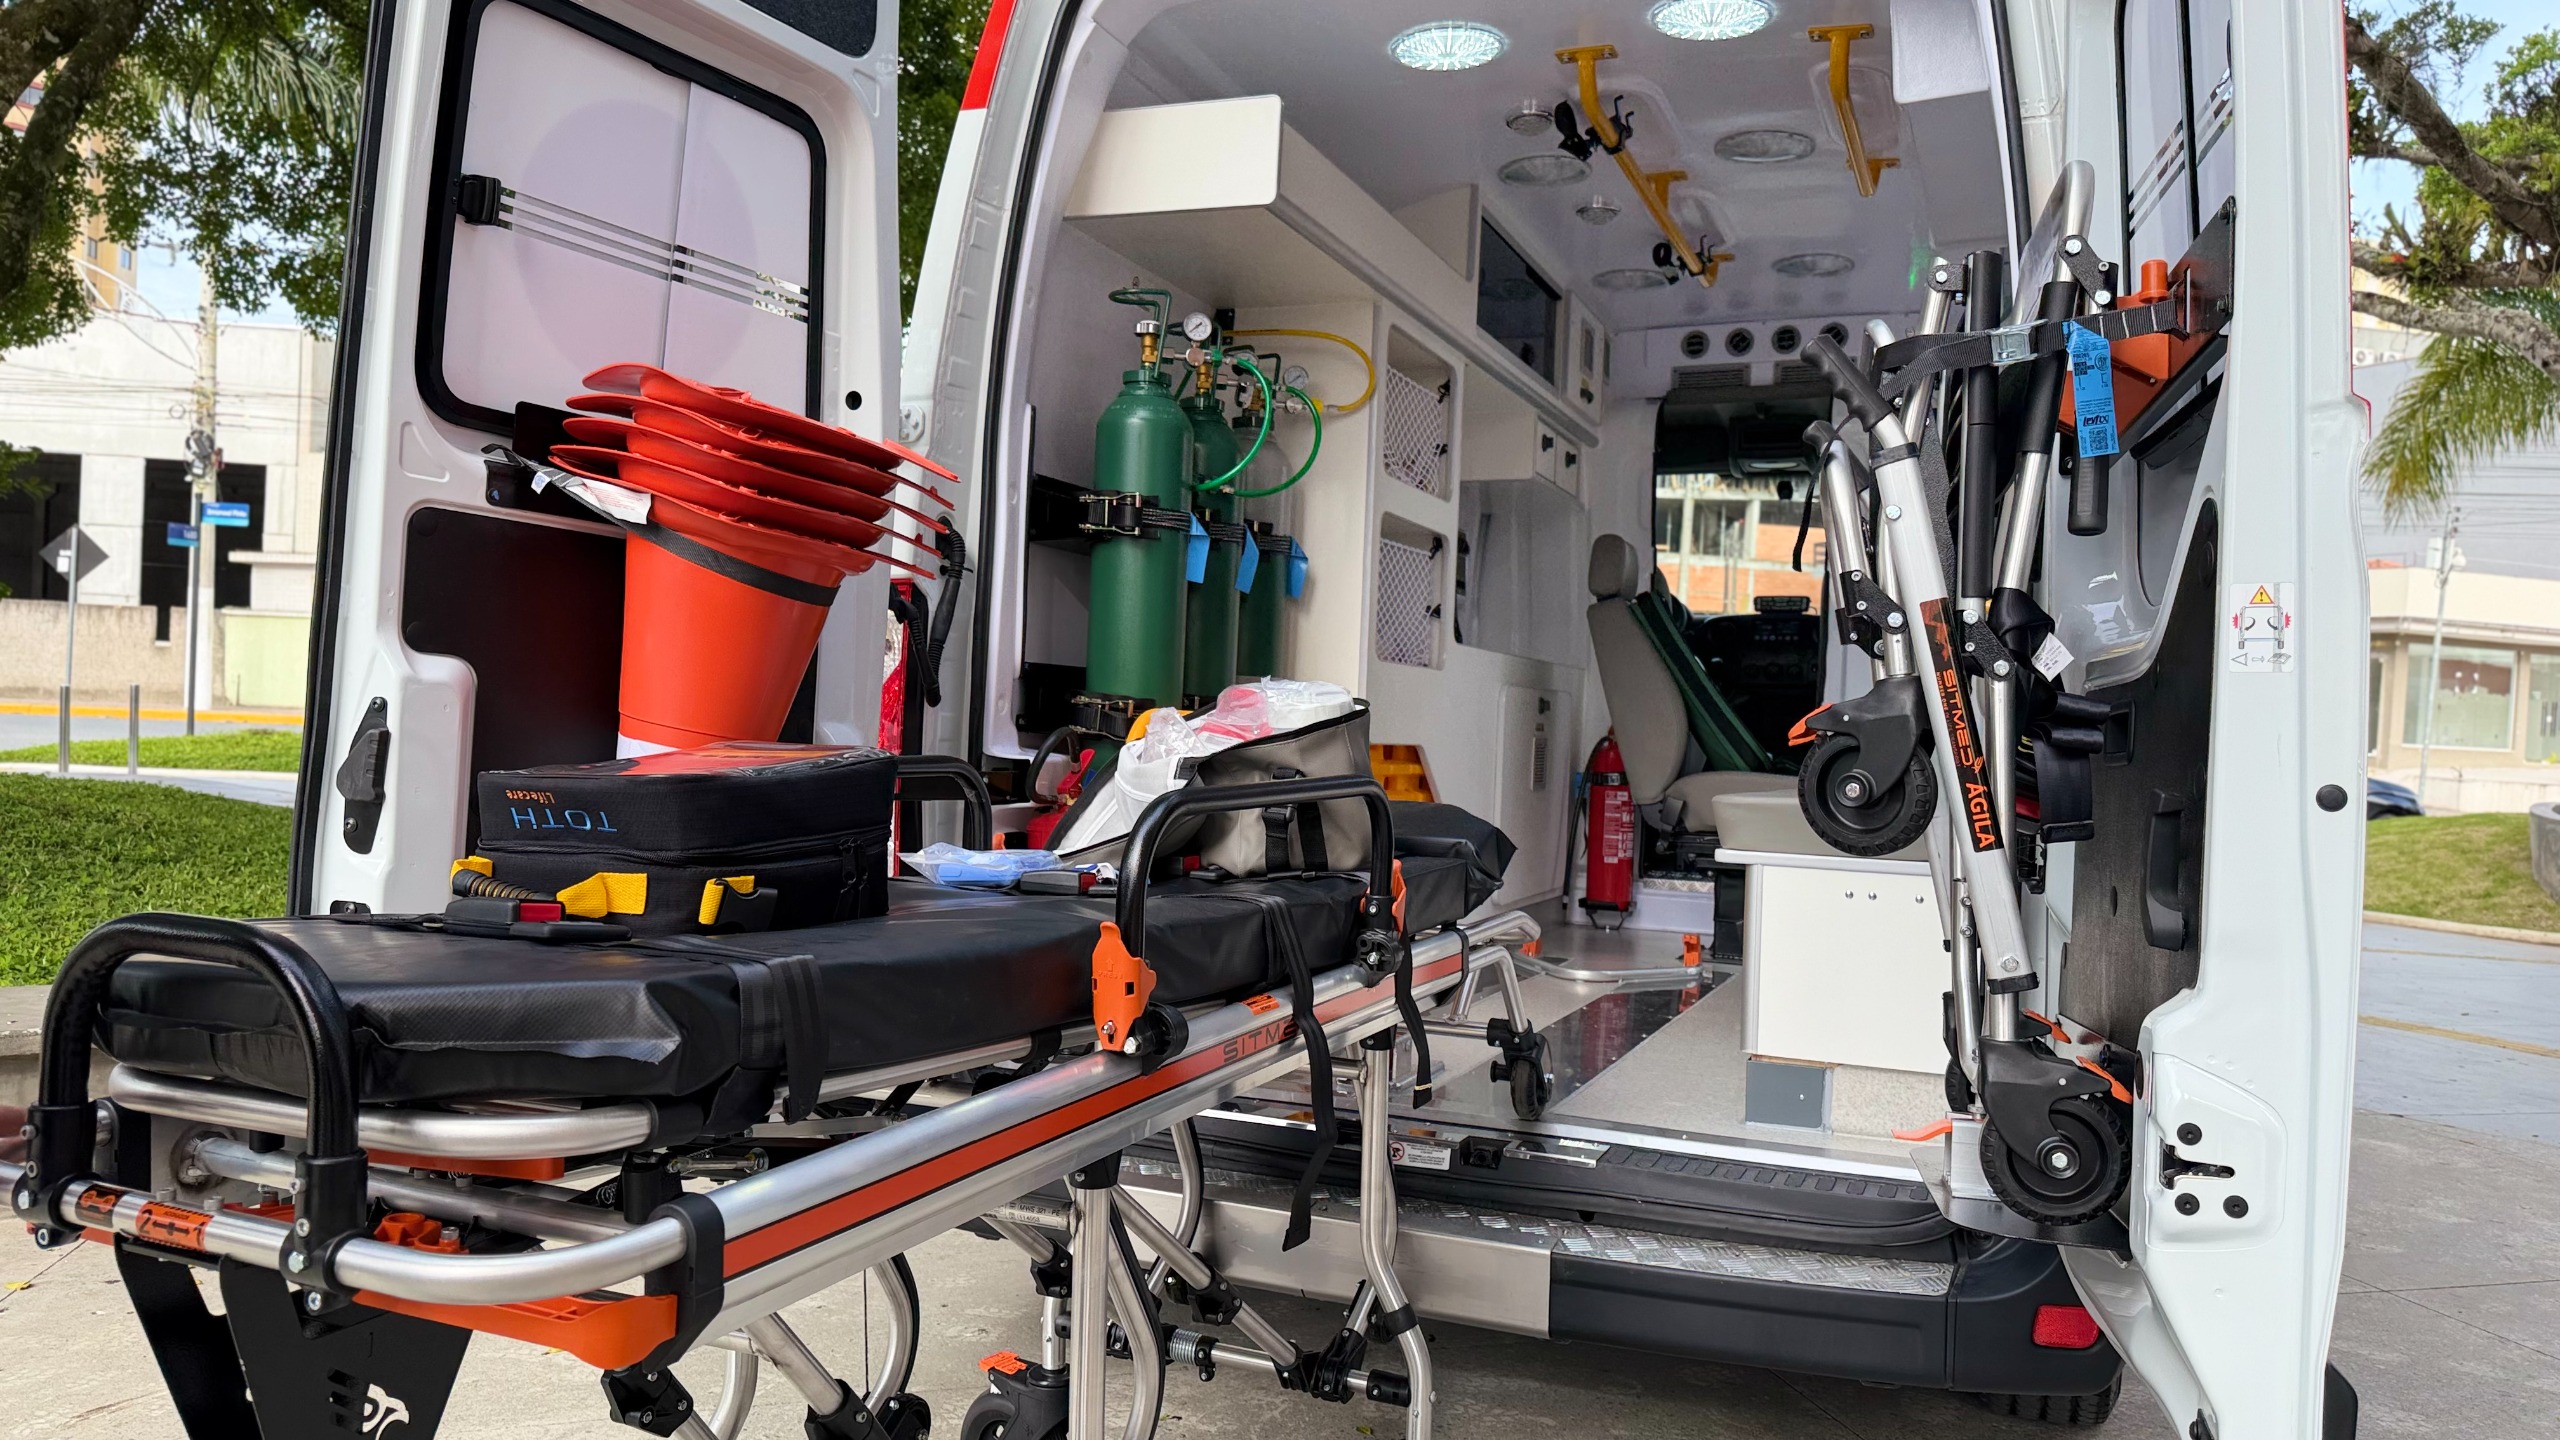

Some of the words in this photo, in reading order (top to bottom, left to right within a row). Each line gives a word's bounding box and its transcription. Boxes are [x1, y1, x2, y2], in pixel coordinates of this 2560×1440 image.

[1943, 668, 1973, 766] SITMED
[505, 789, 556, 804] Lifecare
[510, 807, 618, 832] TOTH
[1966, 782, 1996, 848] ÁGILA
[1223, 1019, 1300, 1063] SITME
[138, 1208, 153, 1235] 2
